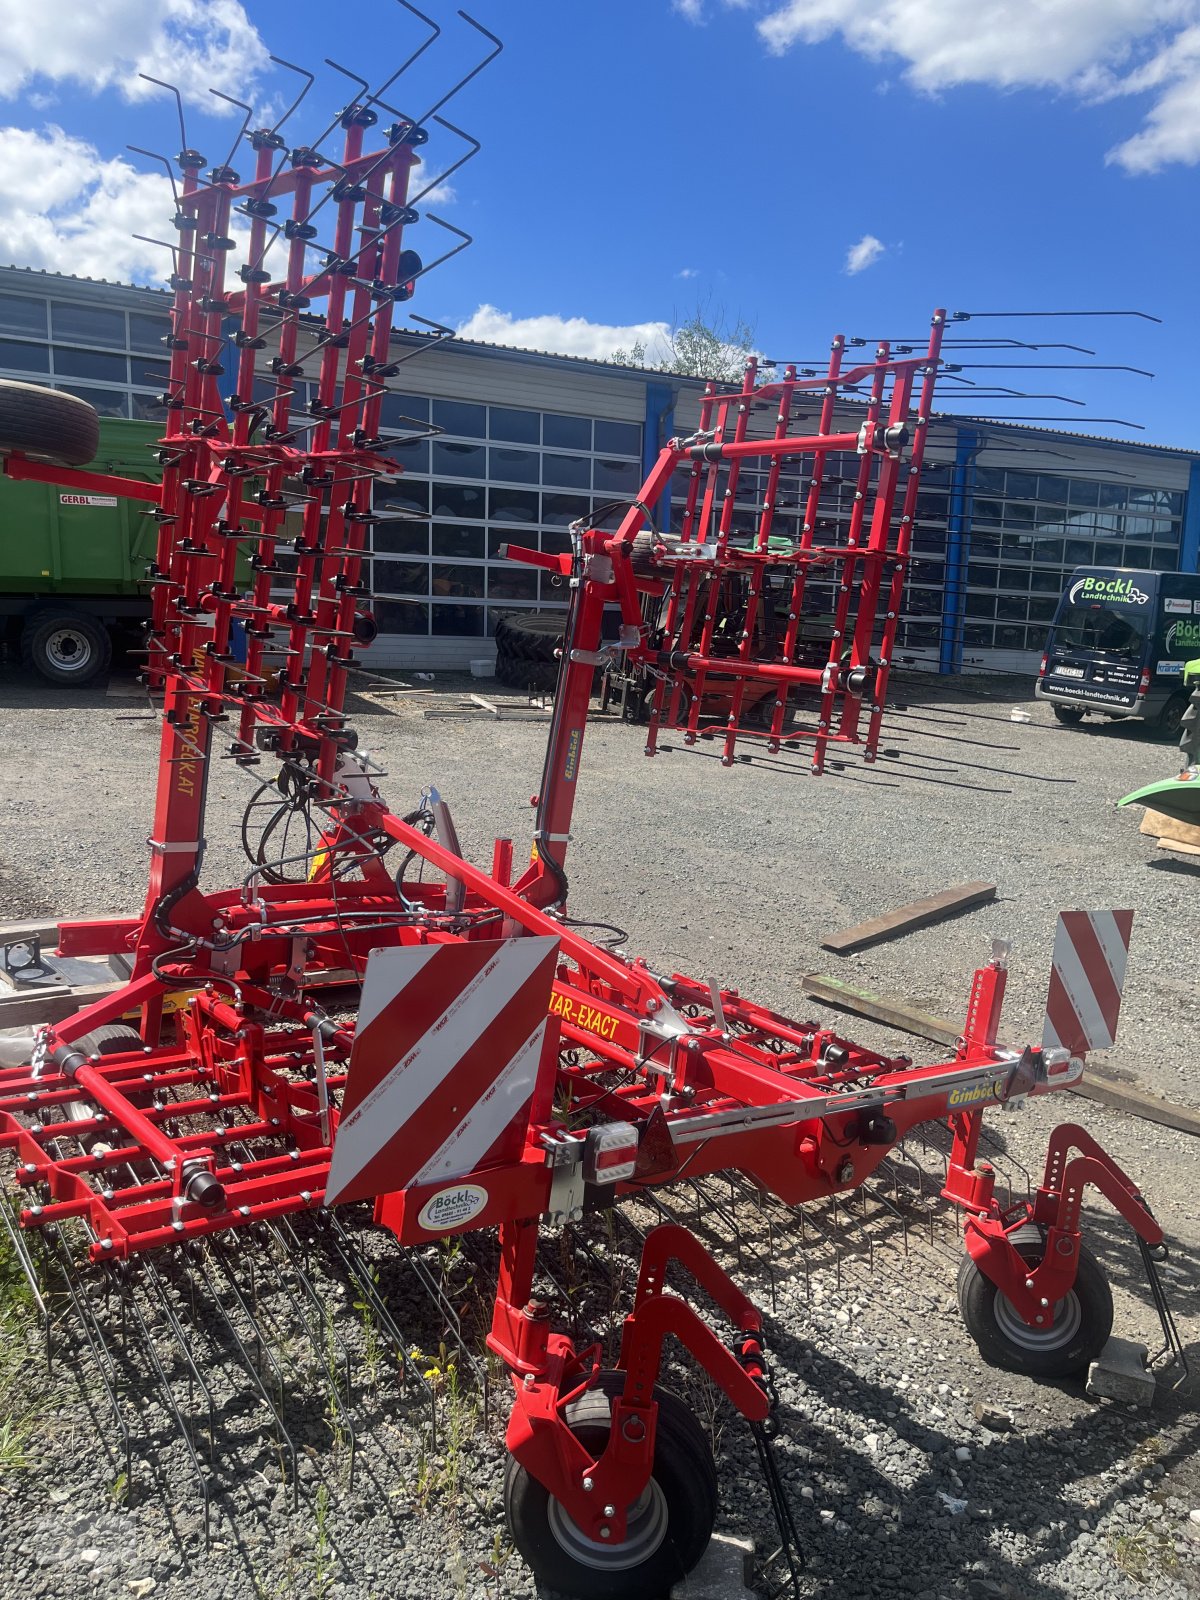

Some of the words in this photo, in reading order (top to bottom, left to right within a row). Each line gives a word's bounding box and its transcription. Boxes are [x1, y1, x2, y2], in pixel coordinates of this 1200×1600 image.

[61, 495, 91, 504] GERBL
[1081, 591, 1128, 603] Landtechnik
[1176, 620, 1200, 637] Böc
[1049, 685, 1130, 703] www.boeckl-landtechnik.de
[436, 1190, 468, 1208] Böckl
